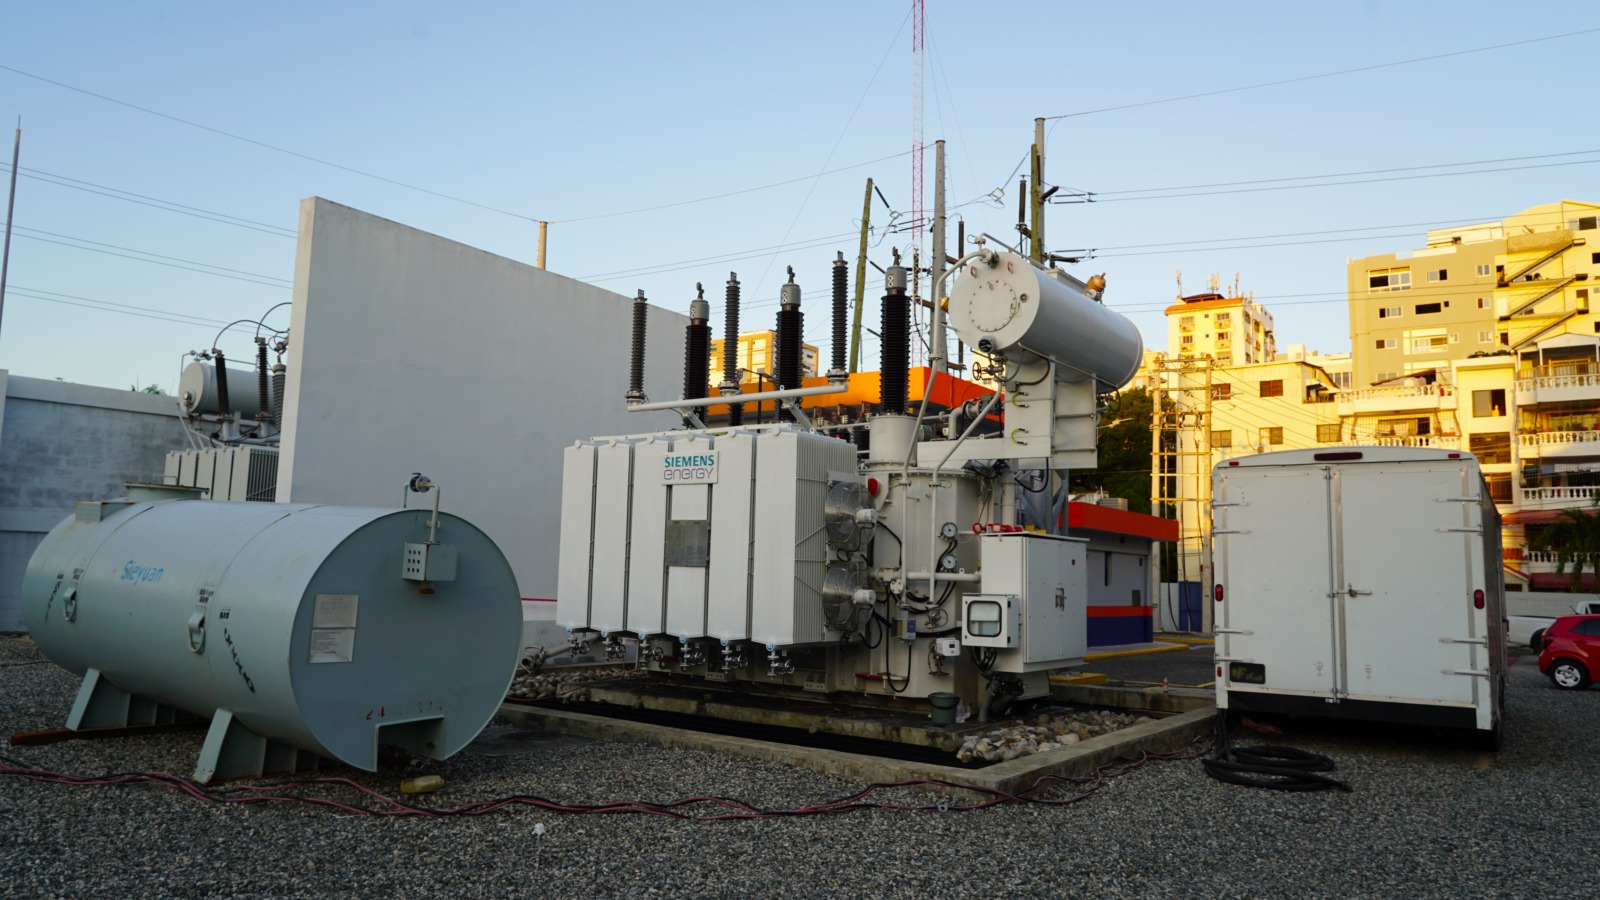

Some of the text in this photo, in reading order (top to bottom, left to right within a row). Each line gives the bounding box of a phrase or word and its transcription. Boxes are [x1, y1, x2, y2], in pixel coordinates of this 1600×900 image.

[664, 454, 715, 468] SIEMENS
[663, 468, 714, 480] energy
[121, 560, 164, 585] Sieyuan
